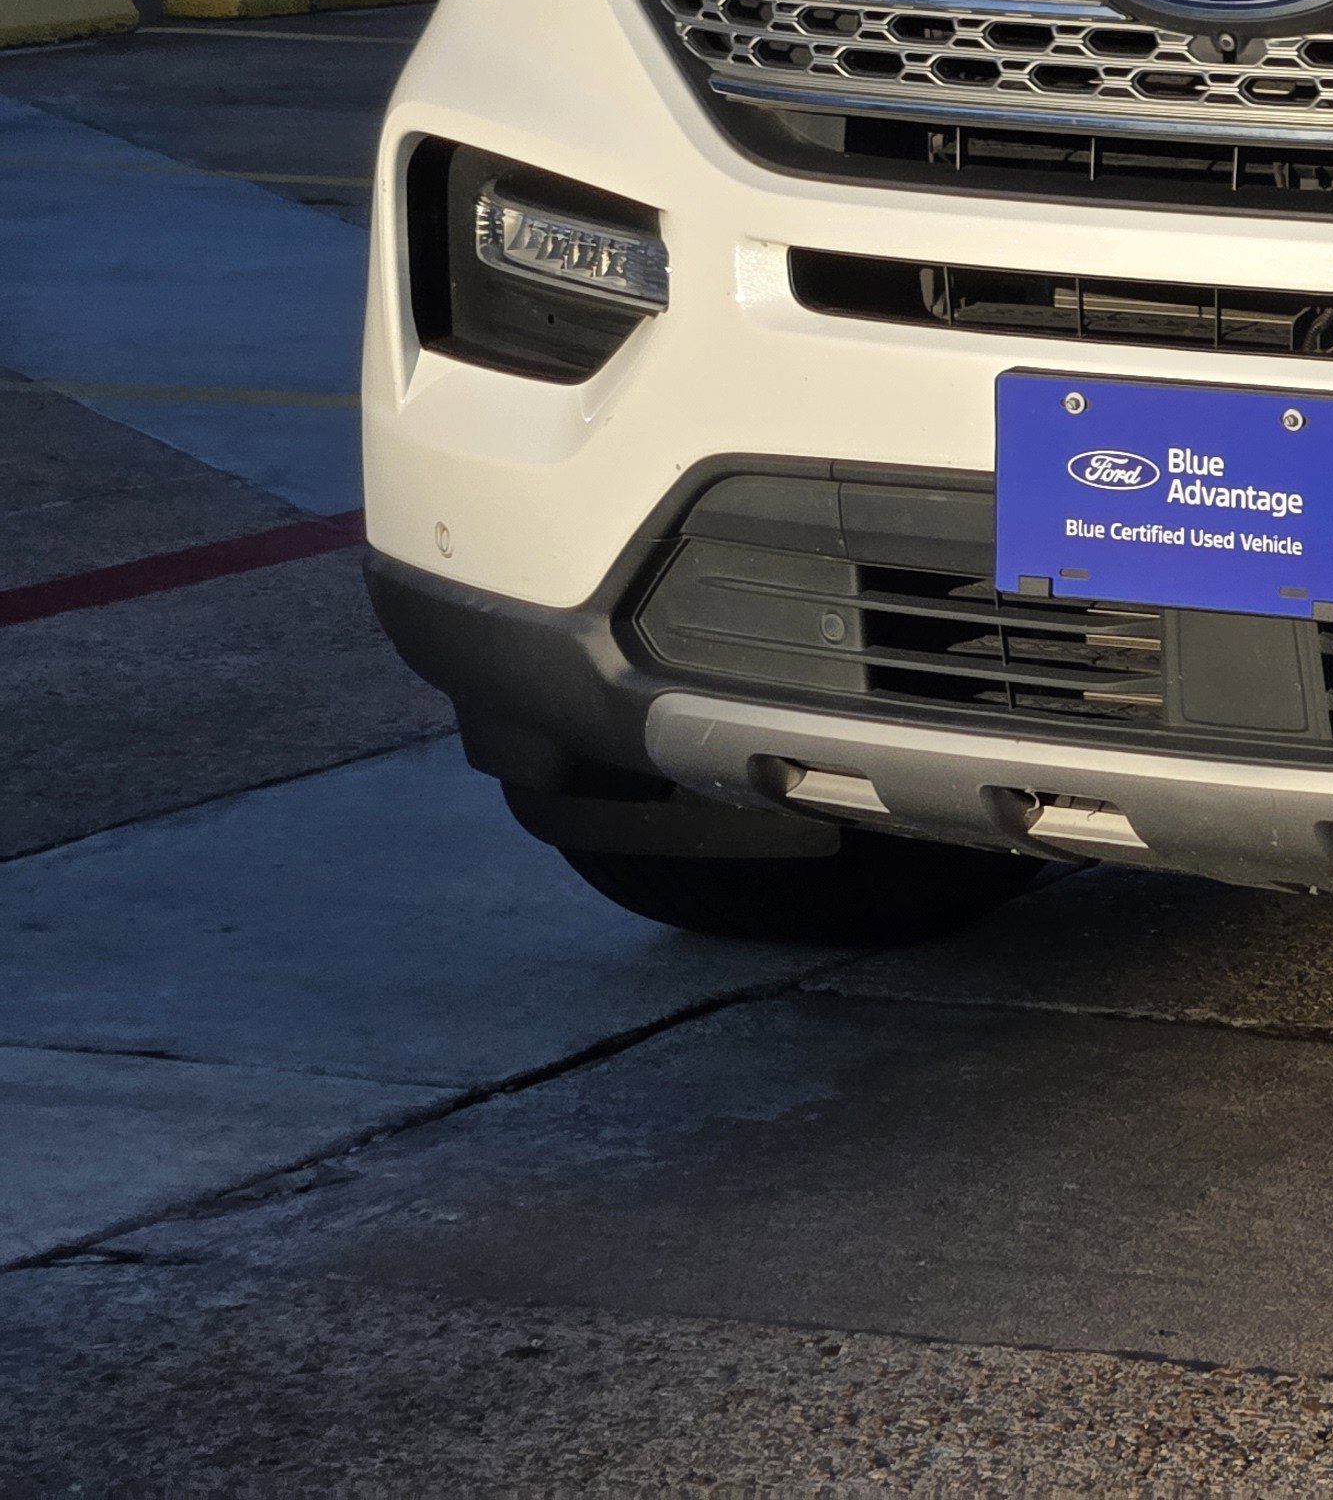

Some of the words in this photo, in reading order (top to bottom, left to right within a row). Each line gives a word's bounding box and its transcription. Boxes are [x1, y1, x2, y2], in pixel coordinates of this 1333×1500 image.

[1085, 454, 1142, 485] Ford
[1168, 448, 1225, 477] Blue
[1167, 479, 1303, 517] Advantage
[1066, 519, 1105, 538] Blue
[1110, 522, 1185, 546] Certified
[1190, 529, 1235, 550] Used
[1240, 533, 1303, 556] Vehicle
